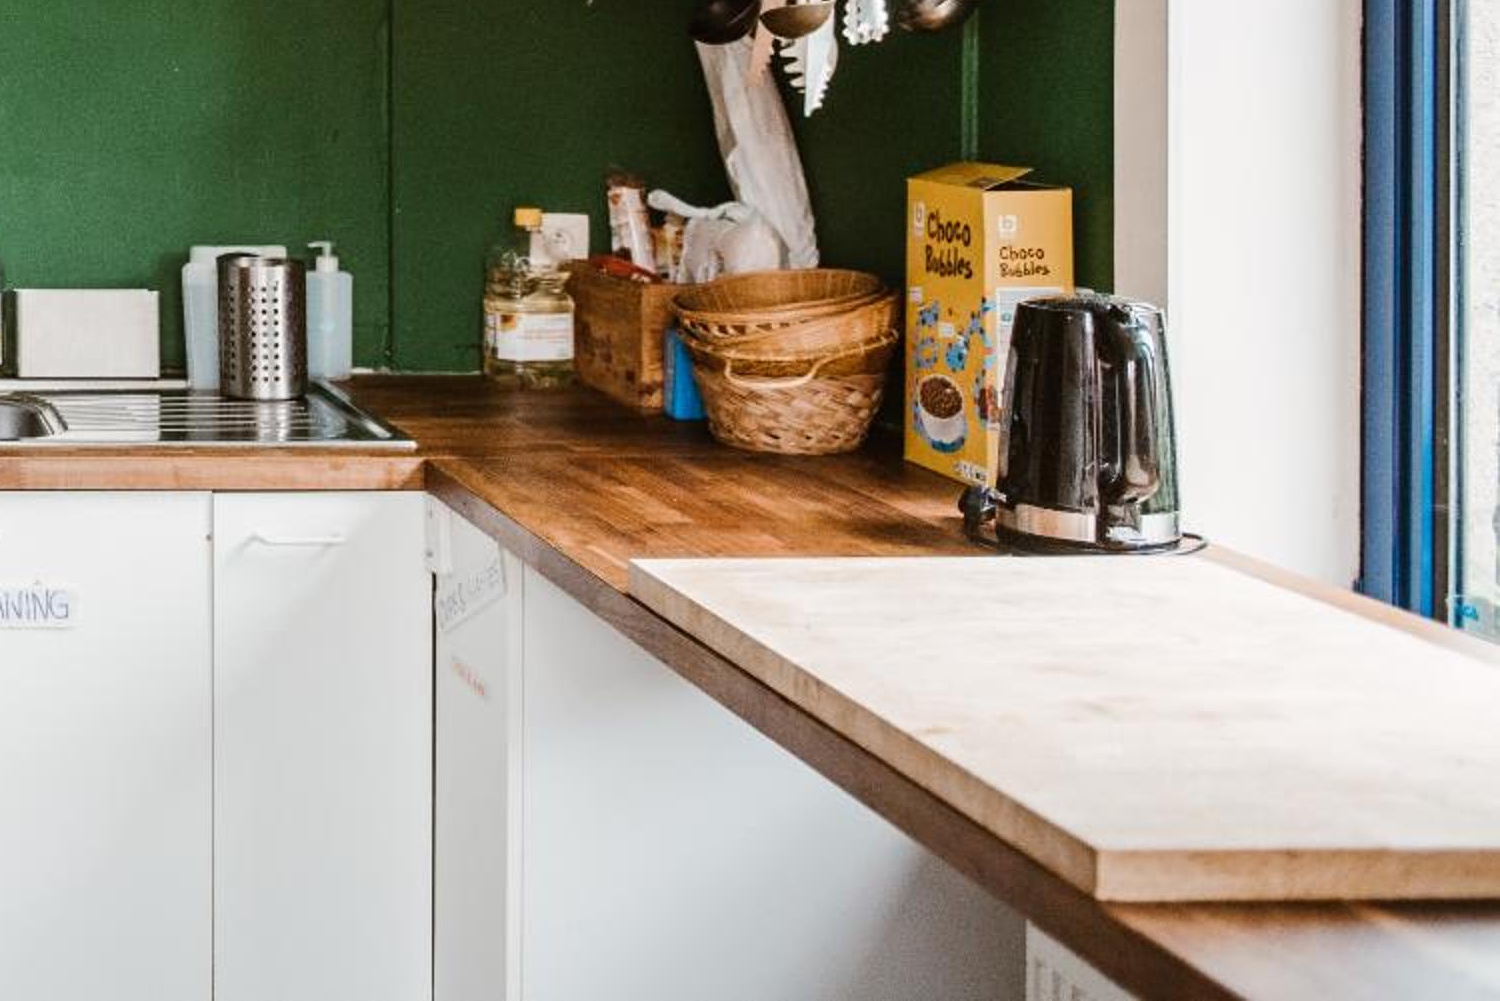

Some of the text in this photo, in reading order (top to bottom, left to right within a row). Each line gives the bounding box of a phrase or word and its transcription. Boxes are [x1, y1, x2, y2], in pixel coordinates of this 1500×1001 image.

[927, 208, 972, 248] Choco
[925, 244, 973, 280] Bubbles
[999, 245, 1045, 261] Choco
[999, 260, 1051, 278] Bubbles
